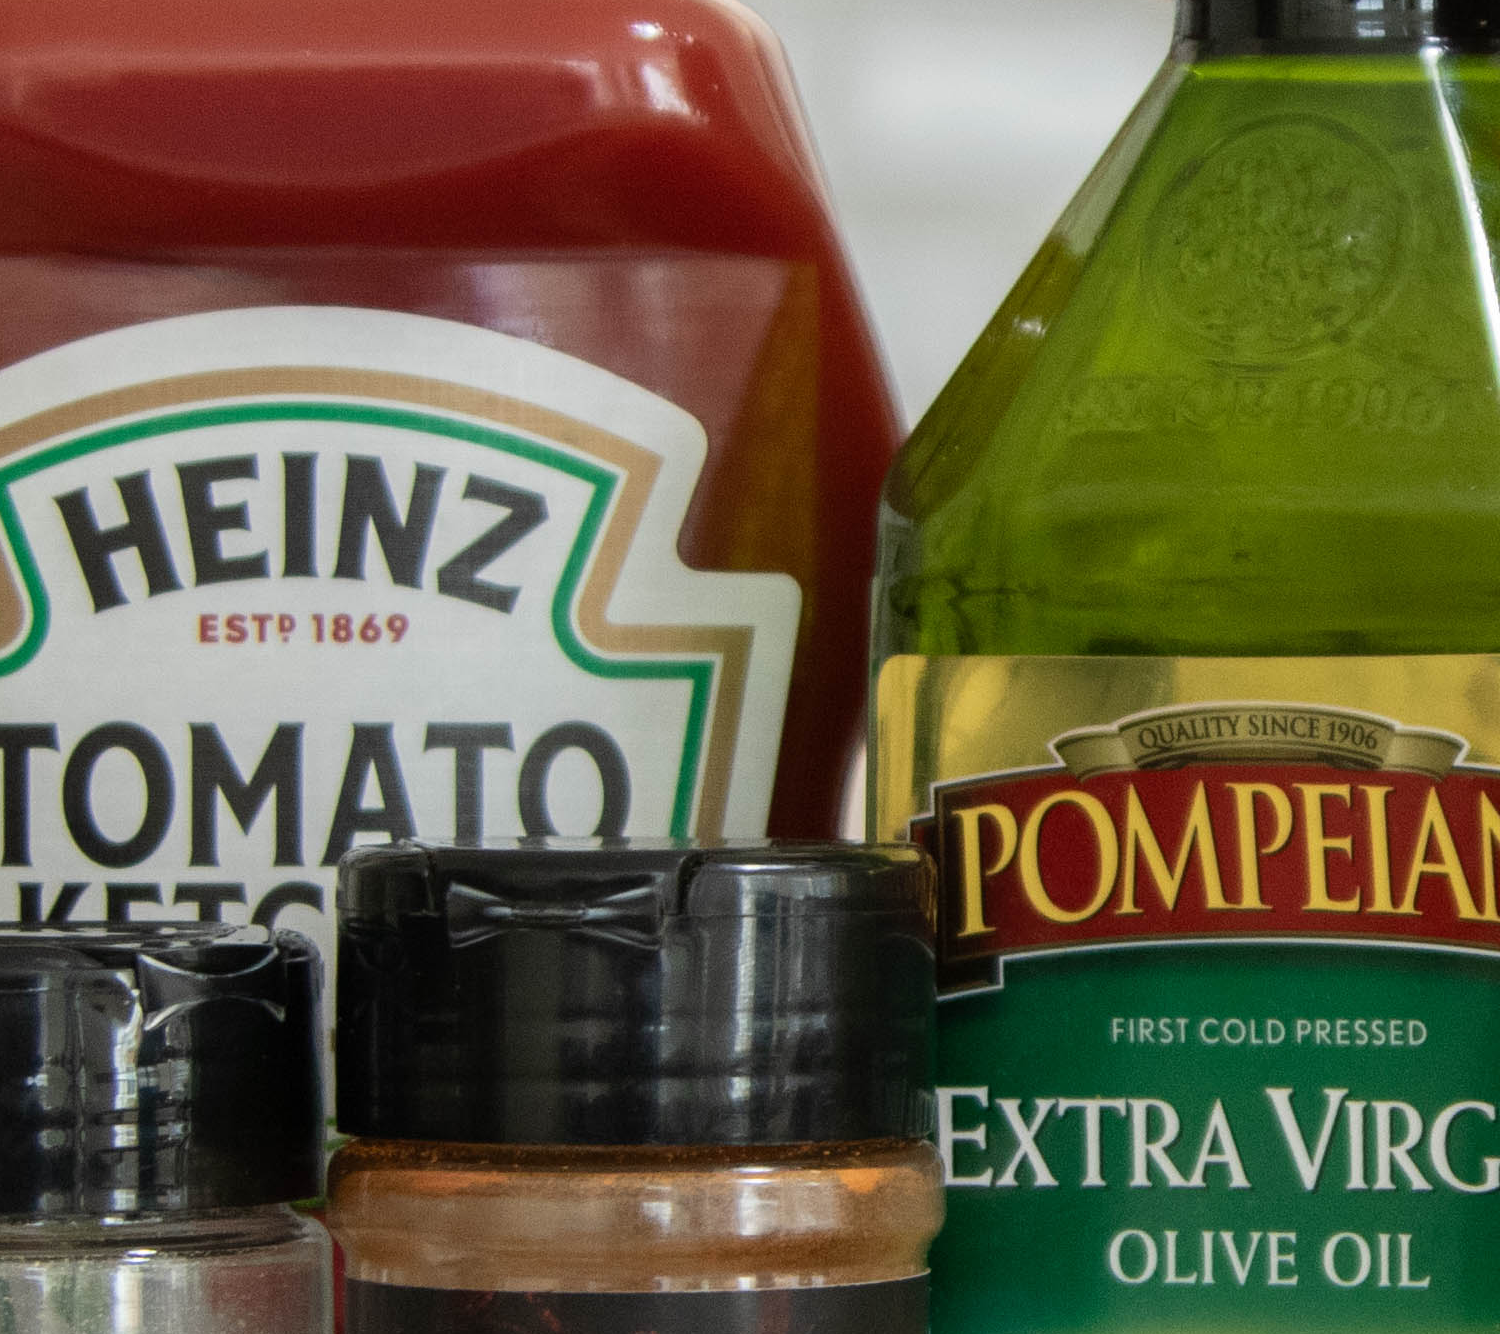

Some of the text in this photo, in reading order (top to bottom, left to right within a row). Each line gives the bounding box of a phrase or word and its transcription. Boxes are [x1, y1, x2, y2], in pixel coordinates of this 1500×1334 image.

[53, 451, 549, 614] HEINZ
[311, 612, 410, 645] 1869
[1138, 713, 1379, 752] QUALITY SINCE 1906
[1111, 1017, 1428, 1048] FIRST COLD PRESSED
[935, 1084, 1252, 1190] EXTRA
[1108, 1228, 1432, 1289] OLIVE OIL
